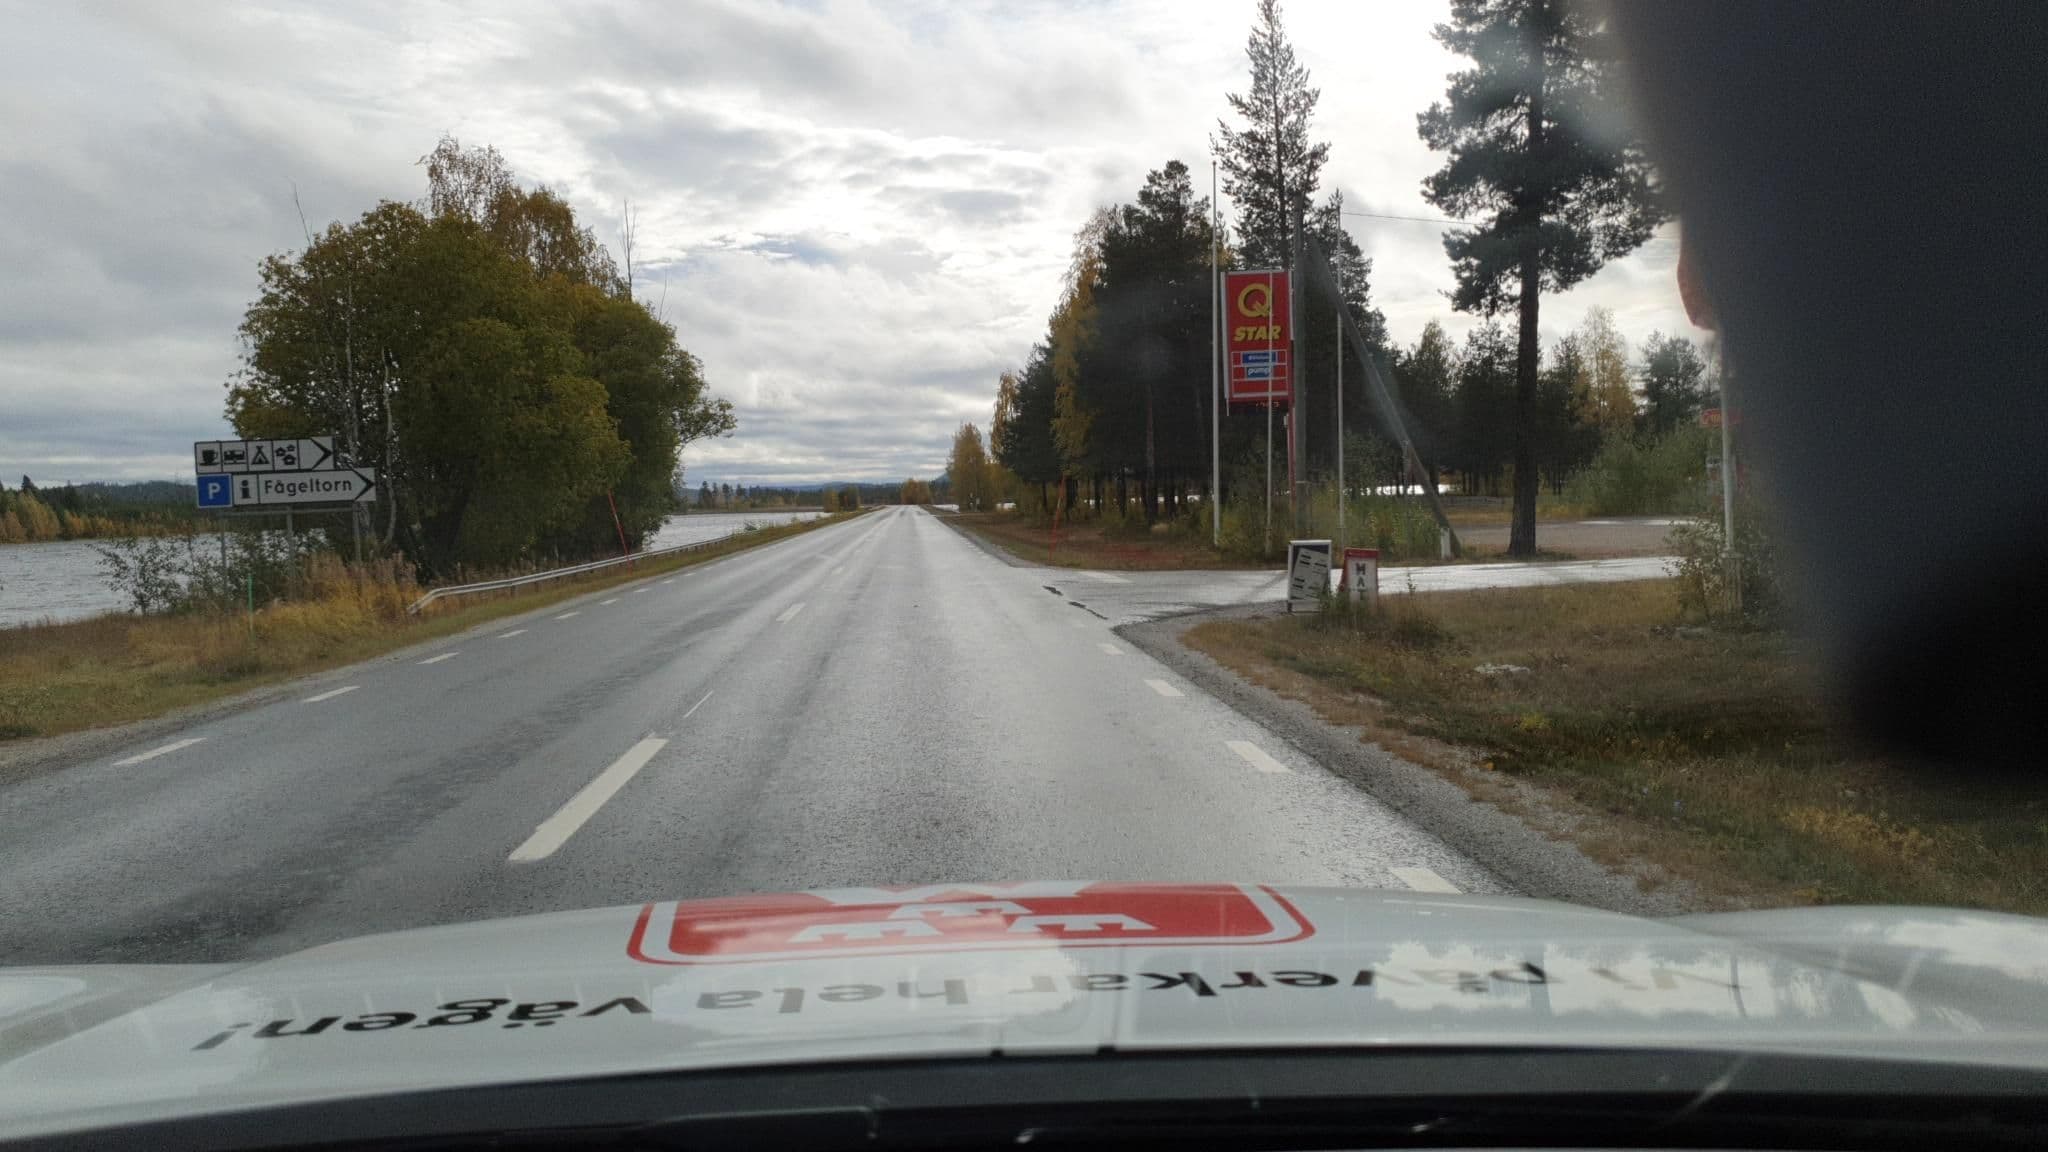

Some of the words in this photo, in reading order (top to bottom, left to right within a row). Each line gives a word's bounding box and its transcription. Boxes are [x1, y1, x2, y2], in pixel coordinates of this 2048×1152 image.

[1238, 283, 1273, 318] Q
[1233, 325, 1281, 342] STAR
[208, 482, 220, 500] P
[264, 478, 352, 497] Fågeltorn
[696, 980, 970, 1014] hela
[192, 996, 651, 1051] vägen!
